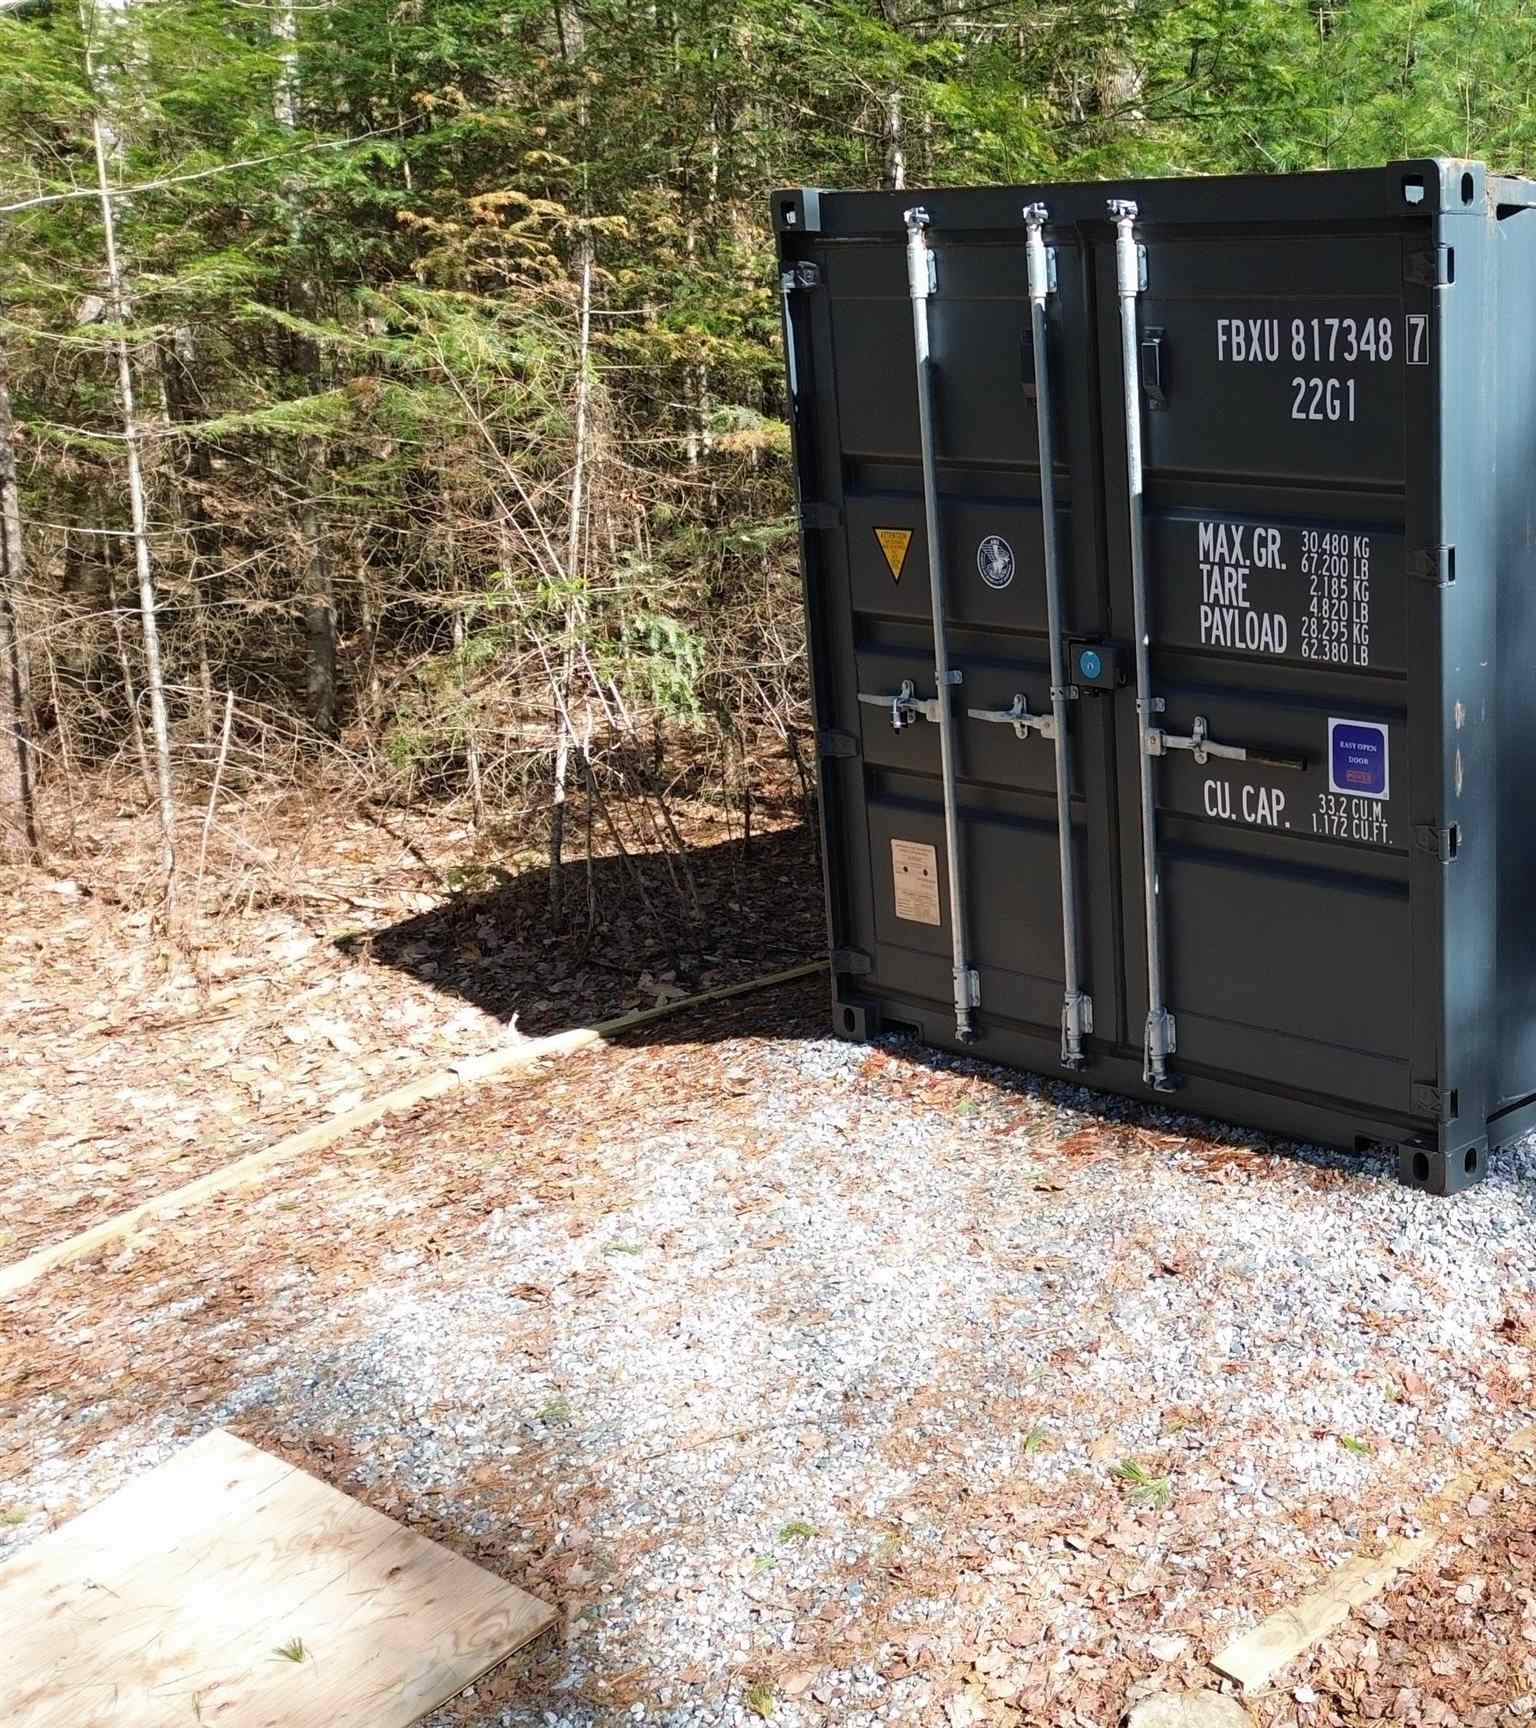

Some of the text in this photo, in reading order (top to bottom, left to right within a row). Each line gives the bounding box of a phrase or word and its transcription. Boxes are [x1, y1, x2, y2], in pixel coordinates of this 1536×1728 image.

[1216, 317, 1425, 362] FBXU 817348 7
[1291, 376, 1355, 421] 22G1
[1353, 536, 1370, 558] KG
[1353, 558, 1369, 580] LB
[1200, 563, 1250, 607] TARE
[1353, 580, 1369, 601] KG
[1353, 601, 1369, 623] LB
[1200, 604, 1288, 653] PAYLOAD
[1353, 623, 1369, 645] KG
[1353, 645, 1369, 666] LB
[1348, 755, 1369, 765] DOOR
[1318, 793, 1348, 817] 33.2
